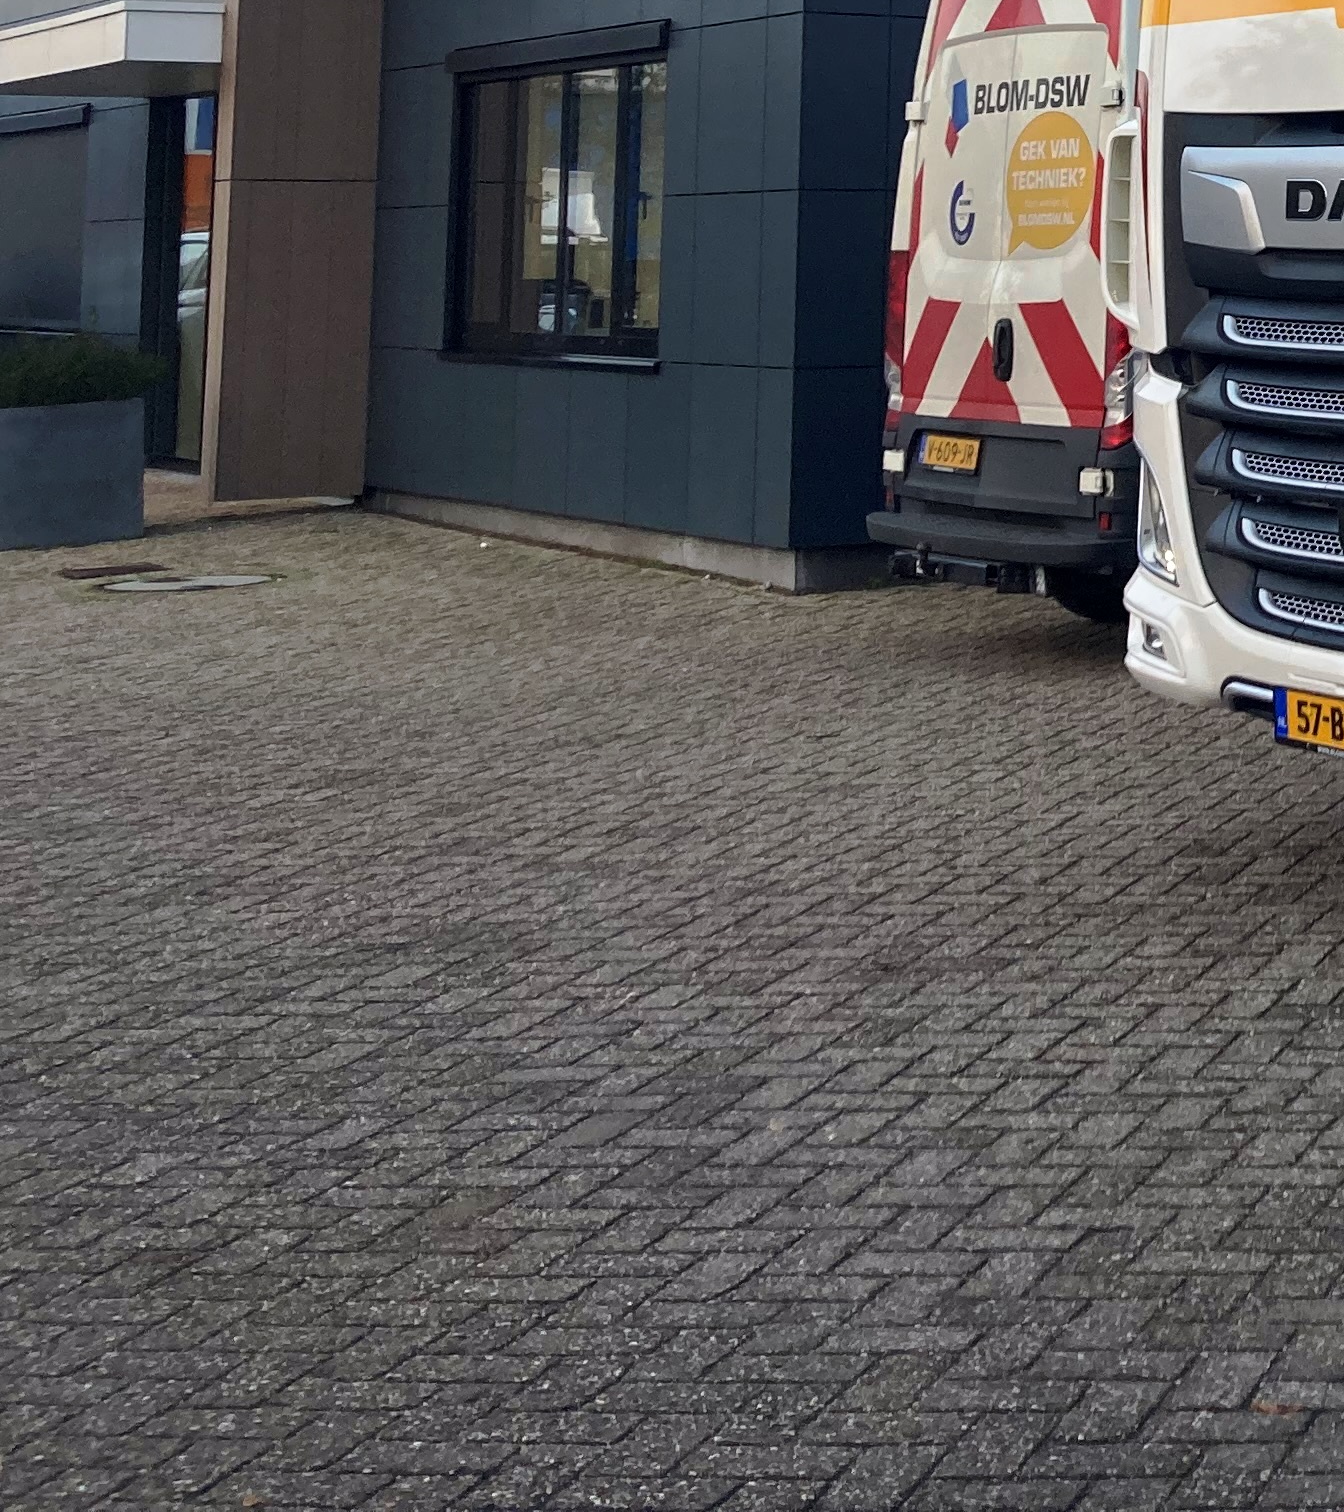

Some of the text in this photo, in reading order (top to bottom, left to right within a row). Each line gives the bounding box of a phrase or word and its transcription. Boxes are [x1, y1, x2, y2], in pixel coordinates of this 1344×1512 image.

[973, 74, 1091, 116] BLOM-DSW
[1019, 138, 1080, 161] GEK VAN
[1012, 167, 1087, 191] TECHNIEK?
